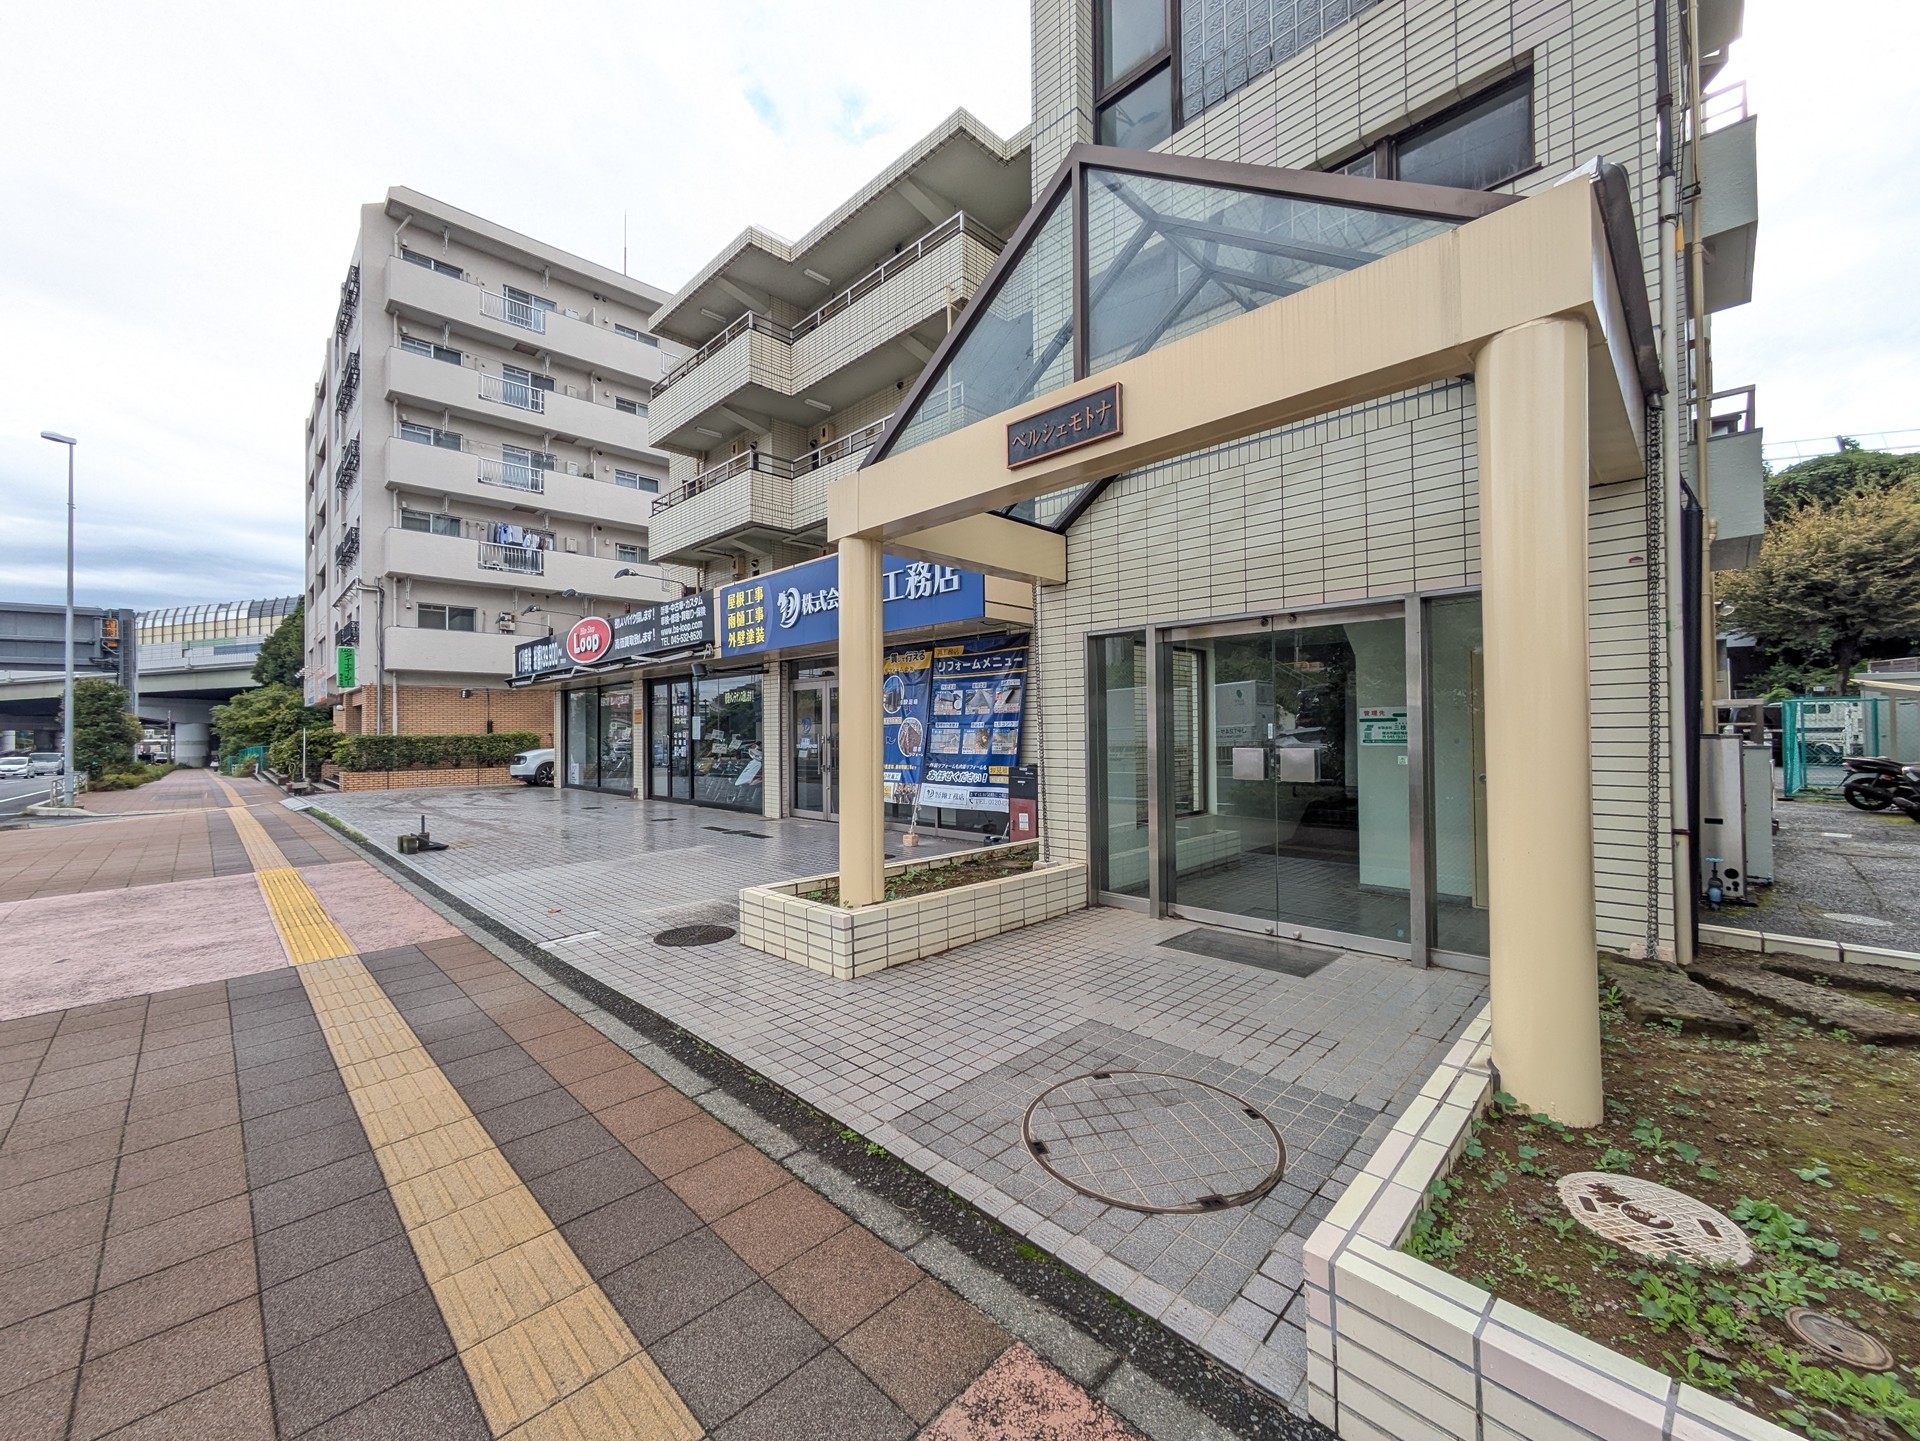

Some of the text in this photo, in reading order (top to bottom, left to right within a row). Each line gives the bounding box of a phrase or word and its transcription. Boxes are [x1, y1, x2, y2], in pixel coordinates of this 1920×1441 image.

[1011, 399, 1112, 449] ベルシェモトナ
[727, 586, 764, 610] 屋根工事
[727, 606, 764, 630] 雨樋工事
[573, 633, 600, 653] Loop
[661, 637, 670, 647] TEL
[727, 626, 765, 648] 外壁塗装
[938, 657, 1023, 672] リフォームメニュー
